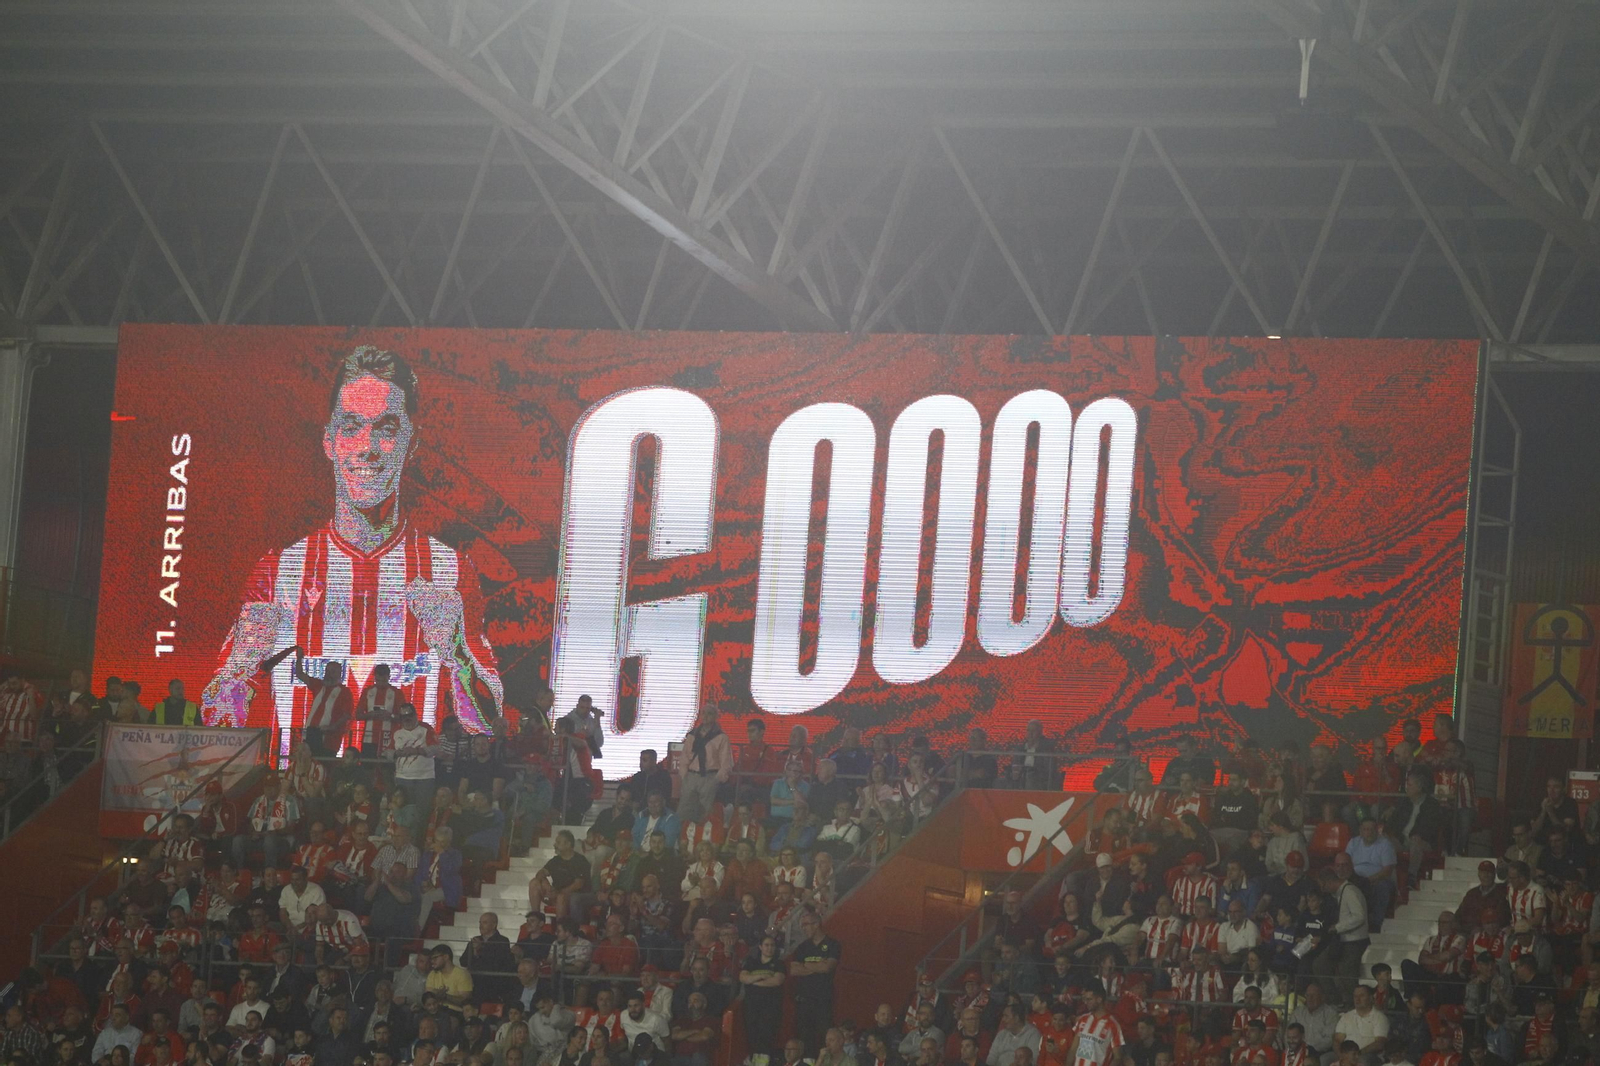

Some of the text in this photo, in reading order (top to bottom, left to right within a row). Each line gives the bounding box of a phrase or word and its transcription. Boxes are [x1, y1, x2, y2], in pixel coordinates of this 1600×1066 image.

[155, 432, 192, 658] 11. ARRIBAS
[121, 729, 152, 743] PEÑA
[1571, 789, 1590, 800] 133
